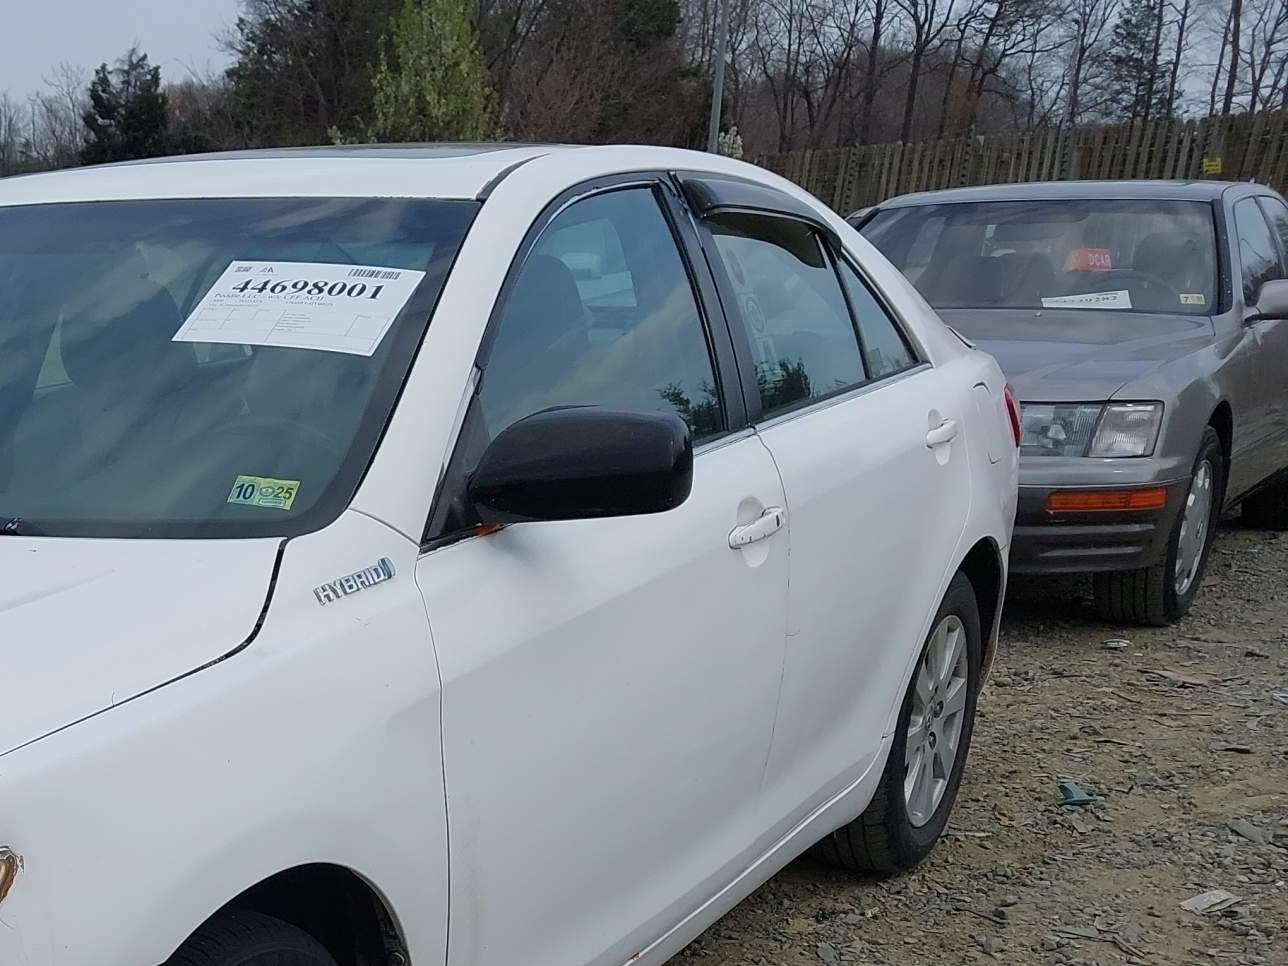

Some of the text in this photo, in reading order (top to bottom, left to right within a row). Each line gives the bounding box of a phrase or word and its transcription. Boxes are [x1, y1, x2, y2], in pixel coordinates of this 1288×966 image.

[232, 278, 385, 300] 44698001
[235, 483, 294, 500] 10 25
[313, 564, 389, 606] HYBRID
